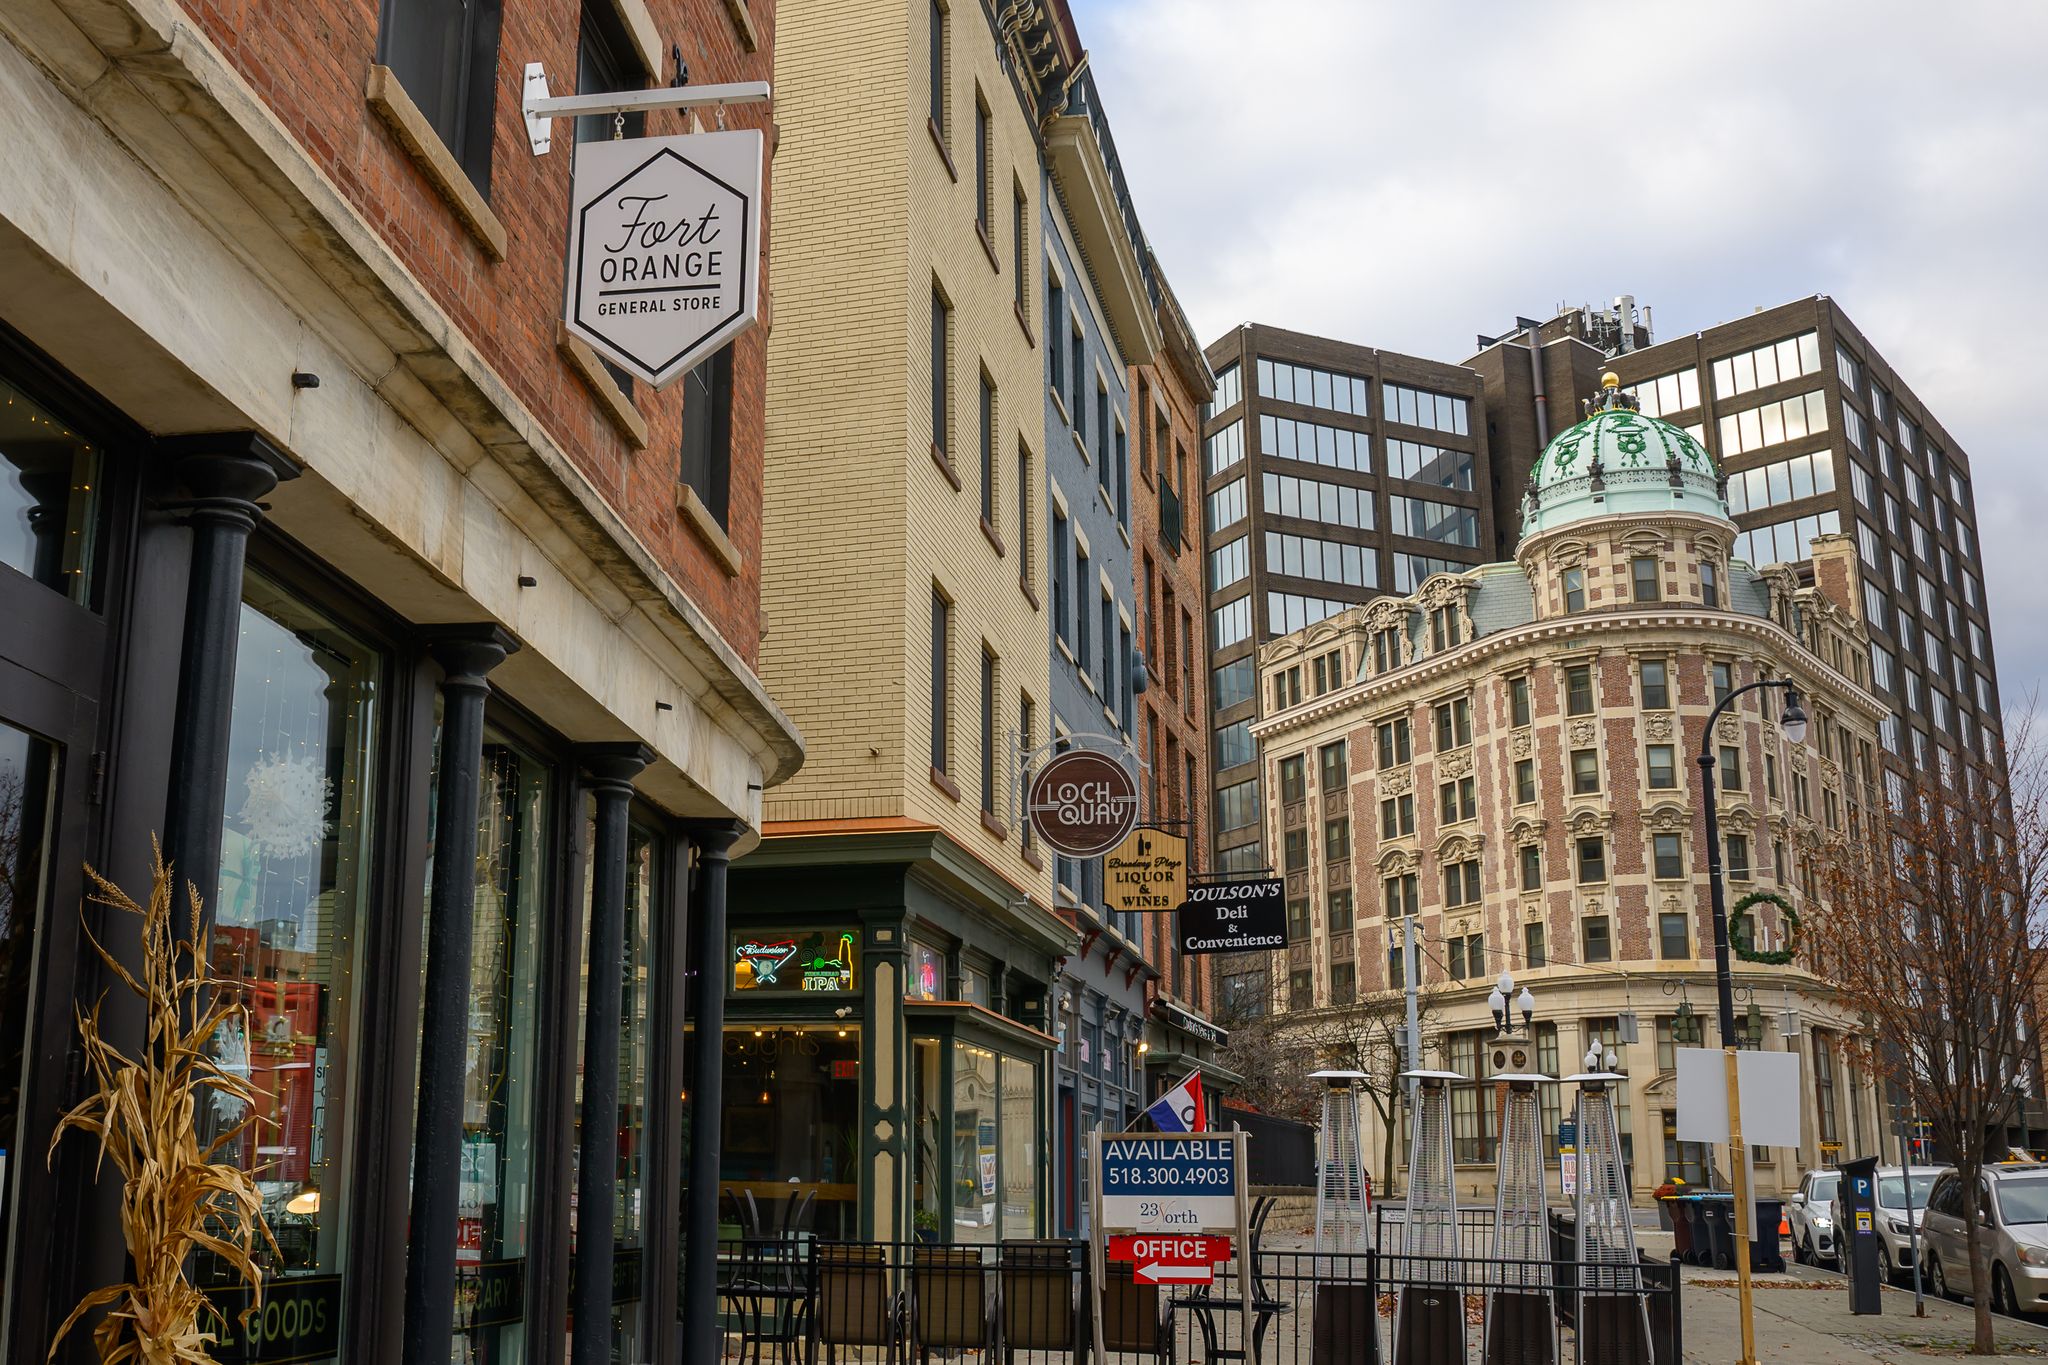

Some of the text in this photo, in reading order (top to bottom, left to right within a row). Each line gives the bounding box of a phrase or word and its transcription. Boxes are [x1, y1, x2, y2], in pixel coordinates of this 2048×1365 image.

[604, 194, 721, 253] Fort
[600, 250, 722, 283] ORANGE
[598, 296, 721, 316] GENERAL STORE
[1047, 781, 1110, 805] LOCH
[1058, 803, 1123, 826] QUAY
[1108, 856, 1182, 871] Broadway Plaza
[1116, 871, 1175, 884] LIQUOR
[1139, 884, 1151, 894] &
[1122, 895, 1169, 907] WINES
[1216, 905, 1248, 920] Deli
[1228, 924, 1238, 933] &
[1185, 933, 1283, 950] Convenience
[803, 976, 840, 991] IPA
[1106, 1140, 1232, 1161] AVAILABLE
[1109, 1167, 1229, 1185] 518.300.4903
[1857, 1179, 1868, 1195] P
[1133, 1239, 1207, 1259] OFFICE
[247, 1297, 328, 1345] GOODS
